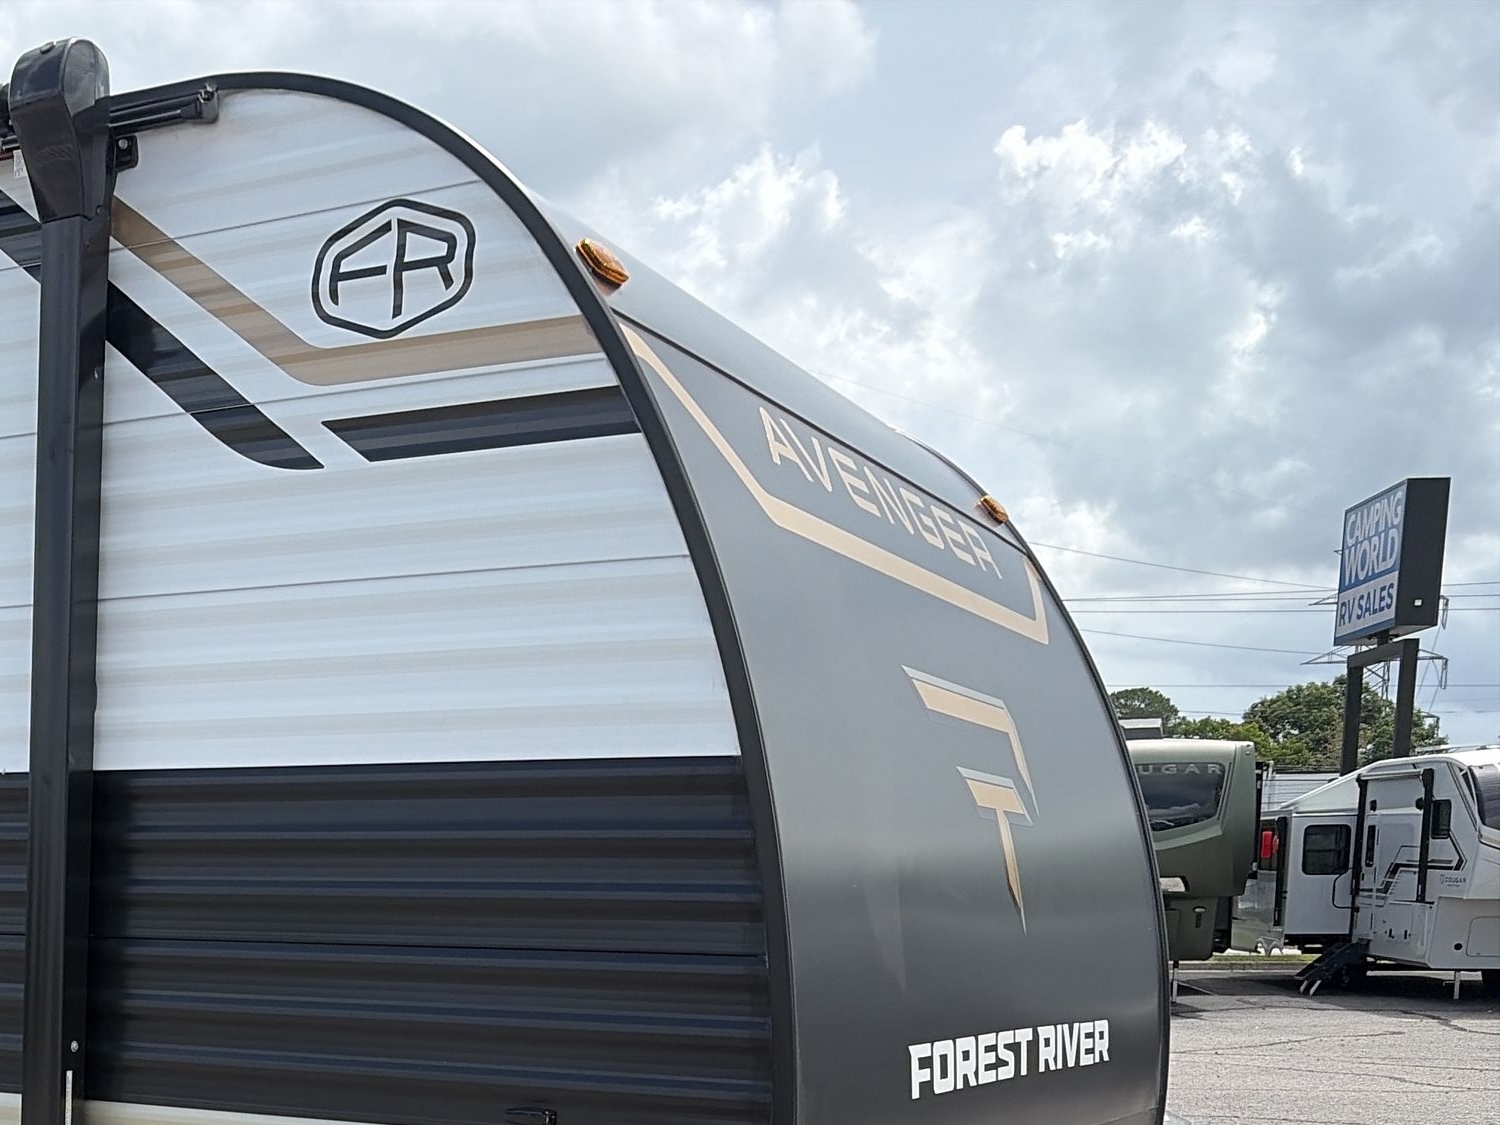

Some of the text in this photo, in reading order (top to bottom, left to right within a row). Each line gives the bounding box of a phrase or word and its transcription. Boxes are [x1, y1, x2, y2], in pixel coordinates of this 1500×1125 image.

[758, 406, 1003, 580] AVENGER
[1347, 491, 1403, 547] CAMPING
[1344, 527, 1399, 587] WORLD
[1338, 582, 1395, 627] RV SALES
[907, 1019, 1110, 1100] FOREST RIVER
